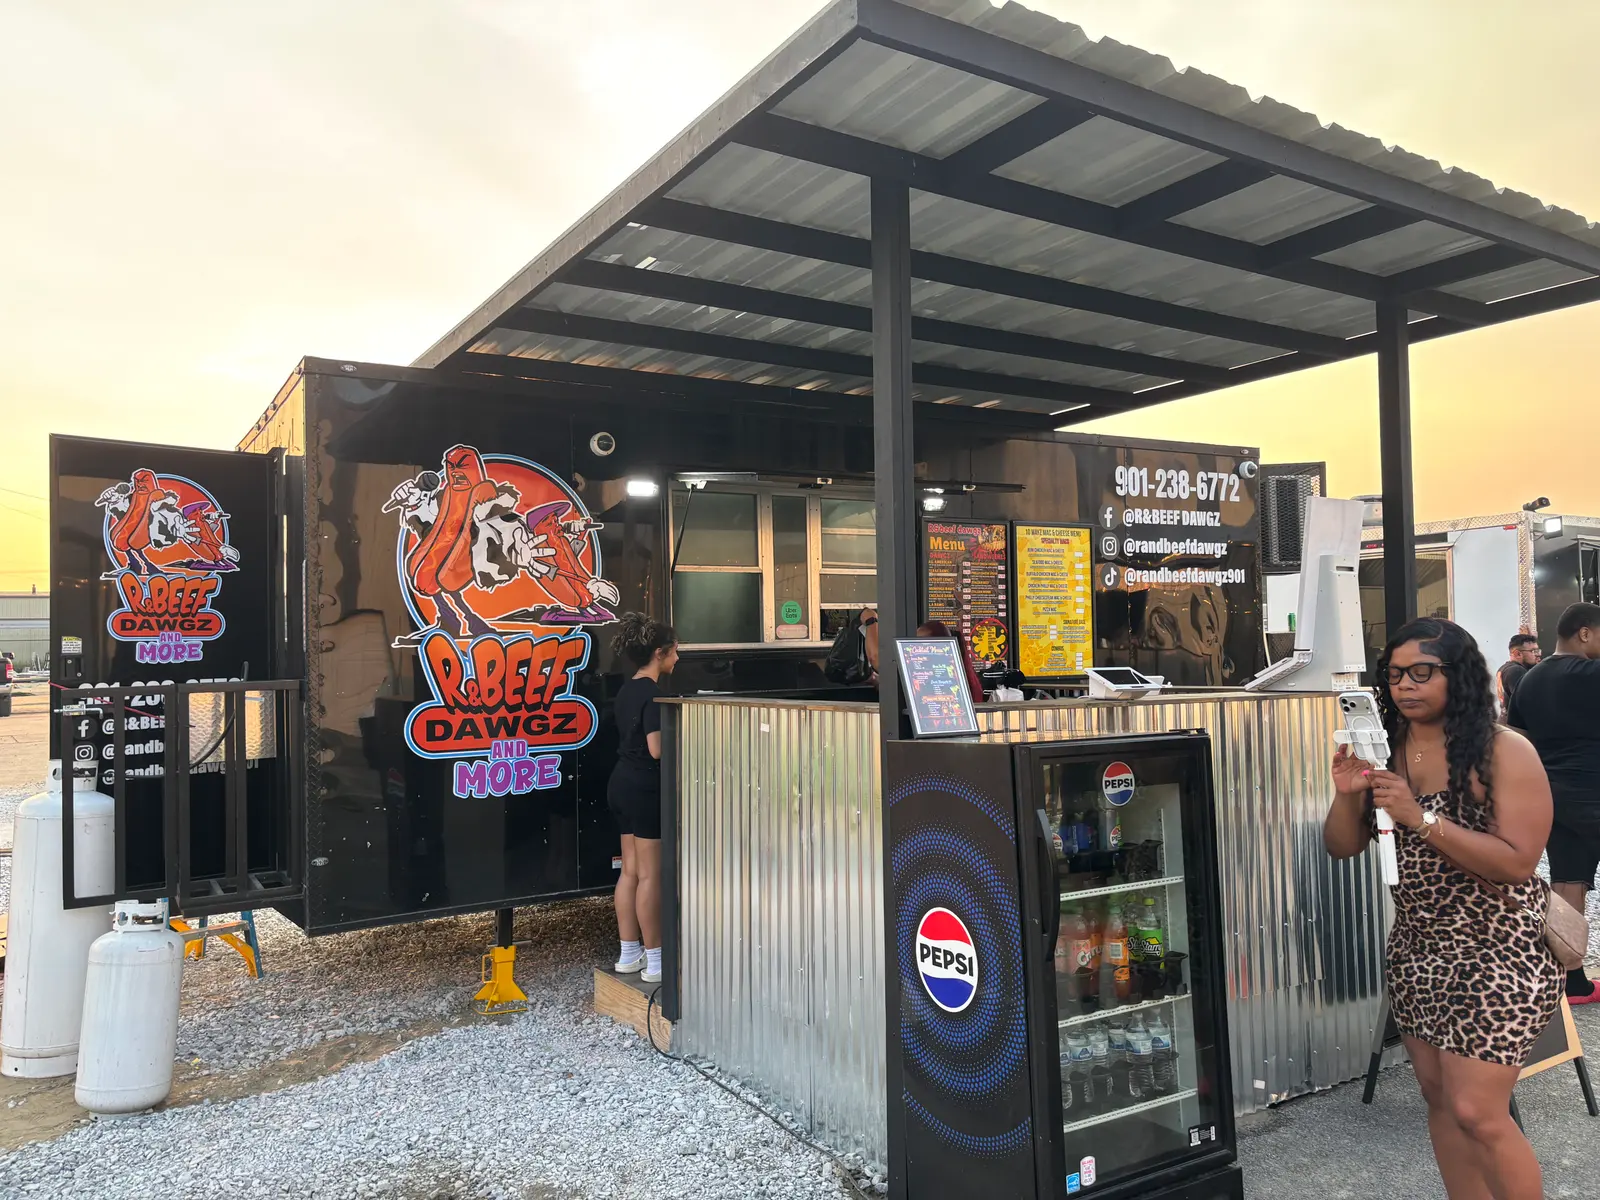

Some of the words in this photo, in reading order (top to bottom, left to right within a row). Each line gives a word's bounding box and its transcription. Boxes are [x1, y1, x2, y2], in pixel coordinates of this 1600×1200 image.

[1115, 465, 1241, 502] 901-238-6772
[1123, 508, 1180, 527] @R&BEEF
[1182, 510, 1221, 527] DAWGZ
[929, 536, 966, 551] Menu
[1123, 537, 1228, 558] @randbeefdawgz
[1124, 567, 1246, 588] @randbeefdawgz901
[120, 573, 218, 617] R&BEEF
[120, 619, 213, 631] DAWGZ
[160, 633, 180, 642] AND
[139, 643, 201, 661] MORE
[425, 633, 586, 714] R&BEEF
[426, 713, 578, 742] DAWGZ
[492, 740, 526, 759] AND
[455, 757, 560, 796] MORE
[1104, 778, 1133, 789] PEPSI
[920, 942, 974, 977] PEPSI
